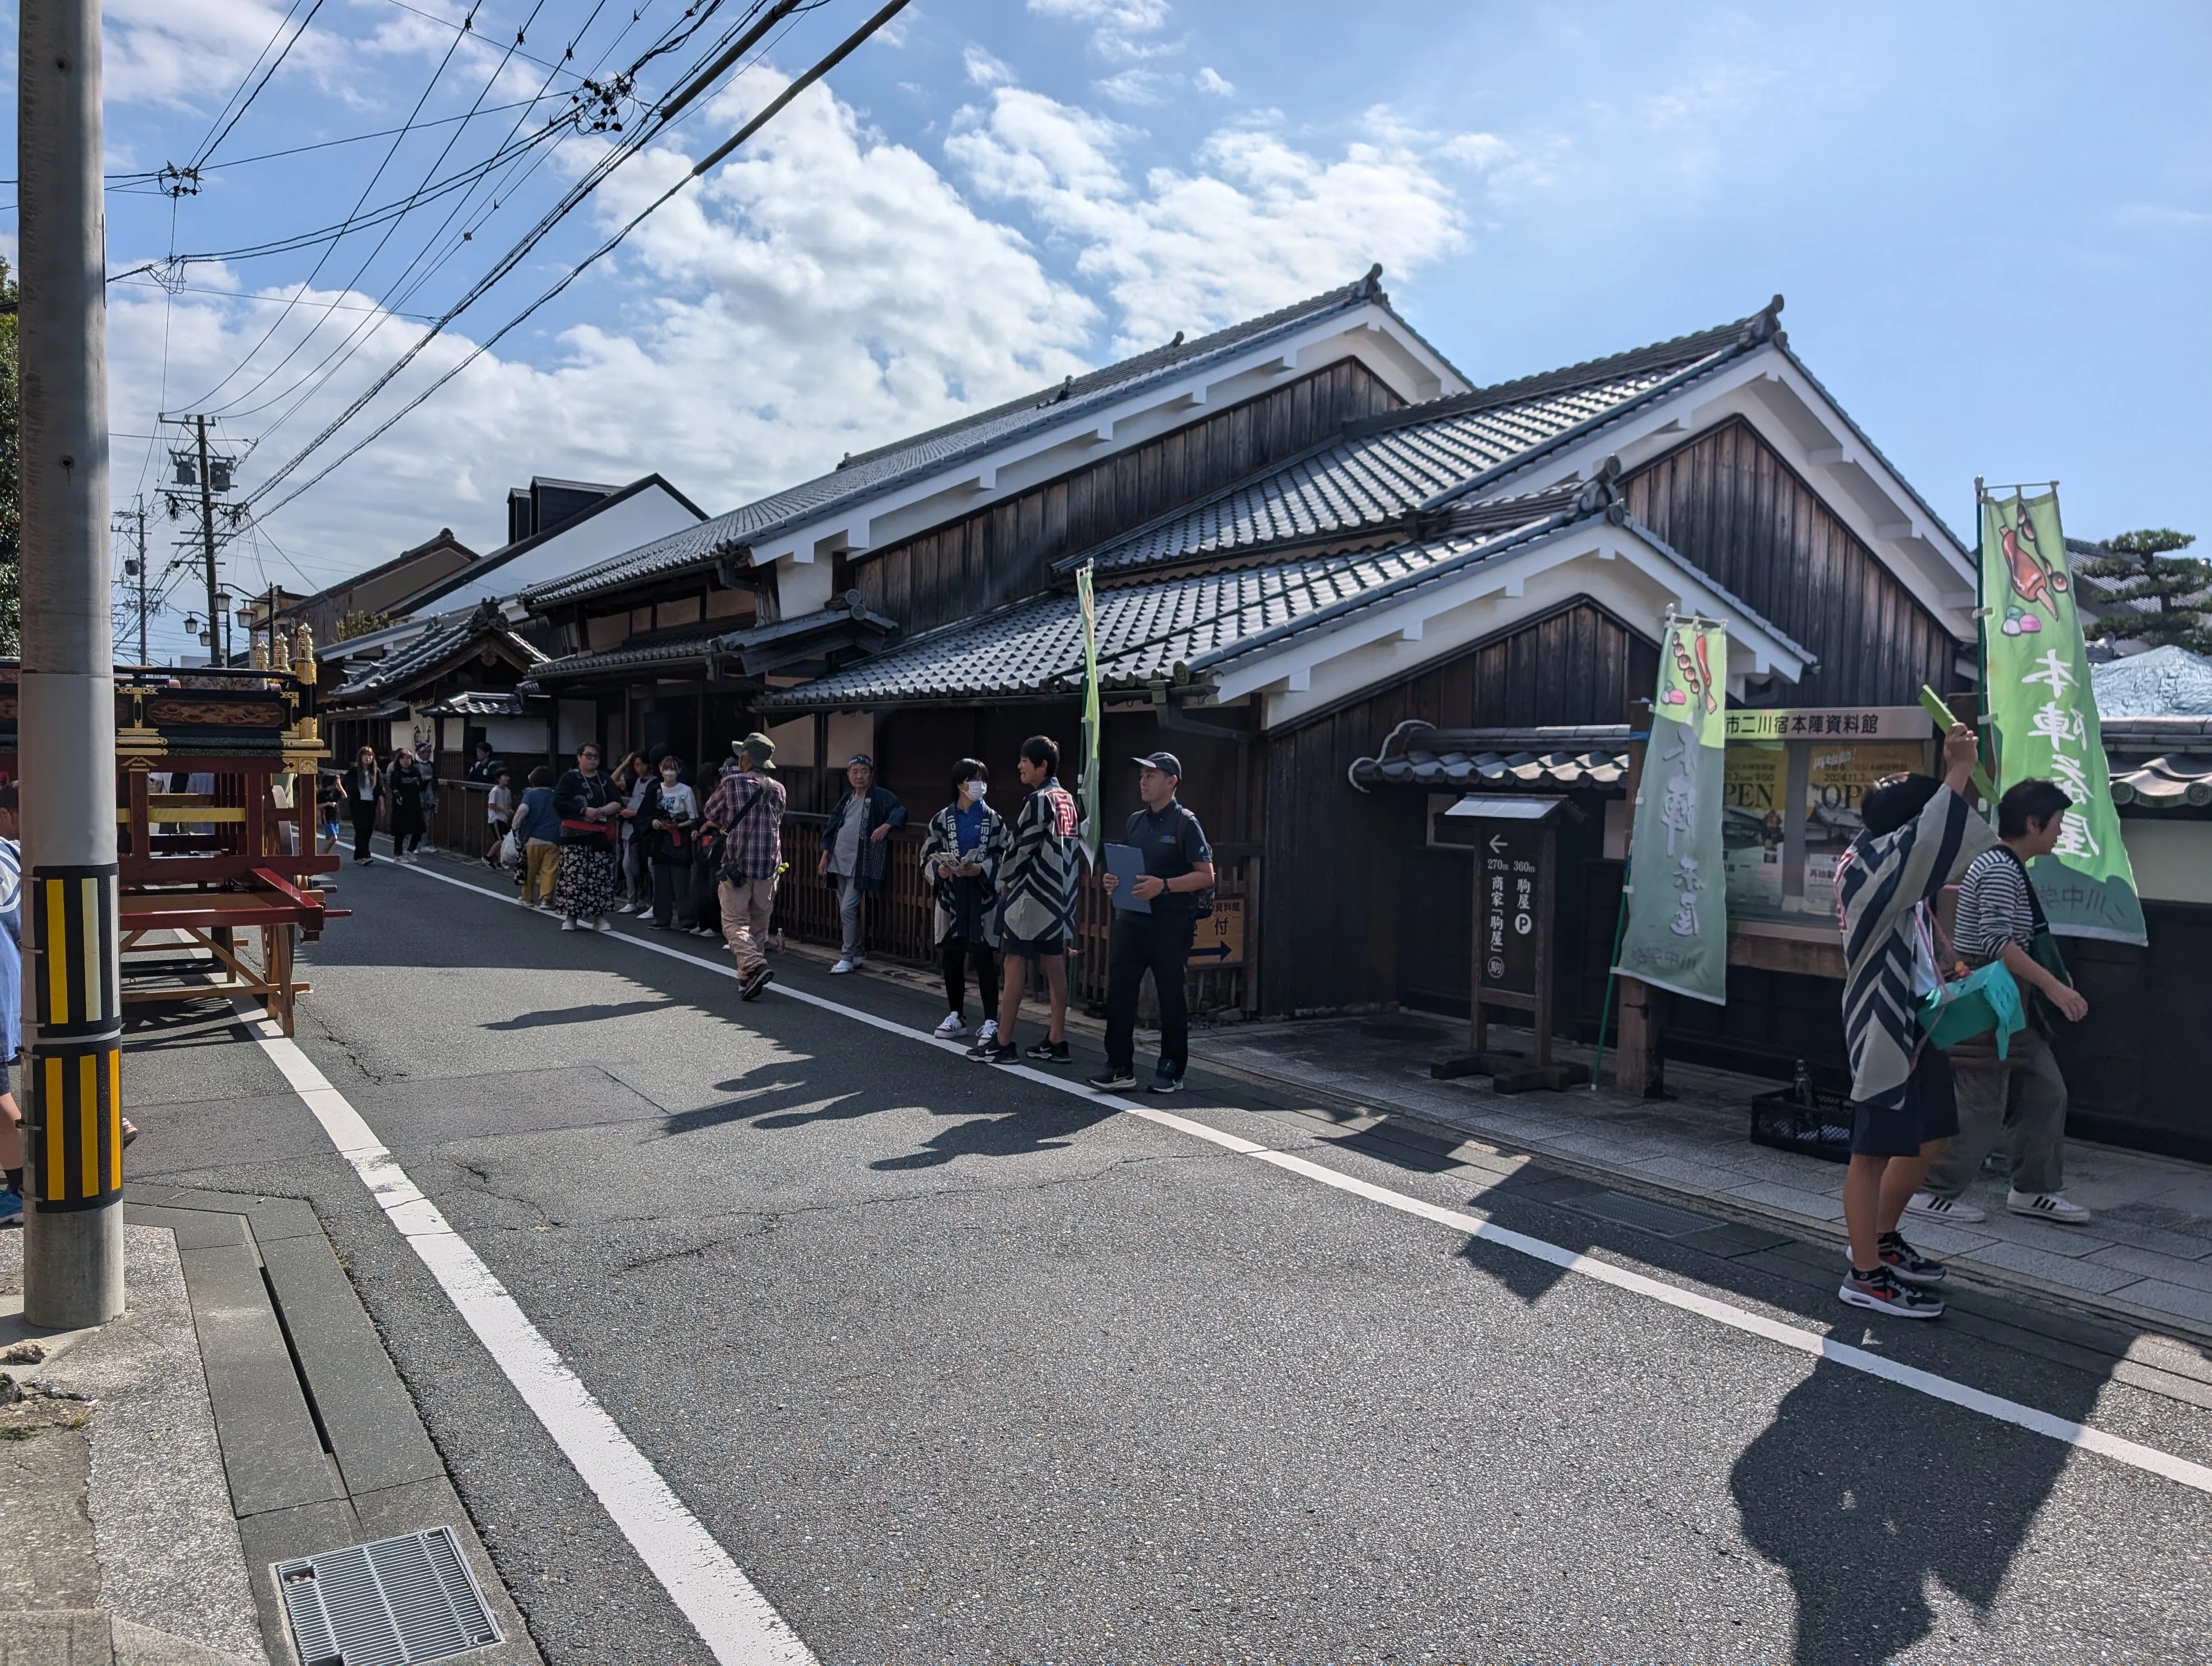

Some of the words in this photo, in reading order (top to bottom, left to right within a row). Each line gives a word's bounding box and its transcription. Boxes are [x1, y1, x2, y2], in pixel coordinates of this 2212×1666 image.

[1726, 714, 1879, 734] 市二川宿本陣資料館
[1487, 858, 1509, 871] 270m
[1513, 860, 1535, 873] 360m
[1516, 878, 1532, 910] 駒屋
[1212, 901, 1240, 912] 資料館
[1490, 875, 1504, 953] 商家「駒屋」
